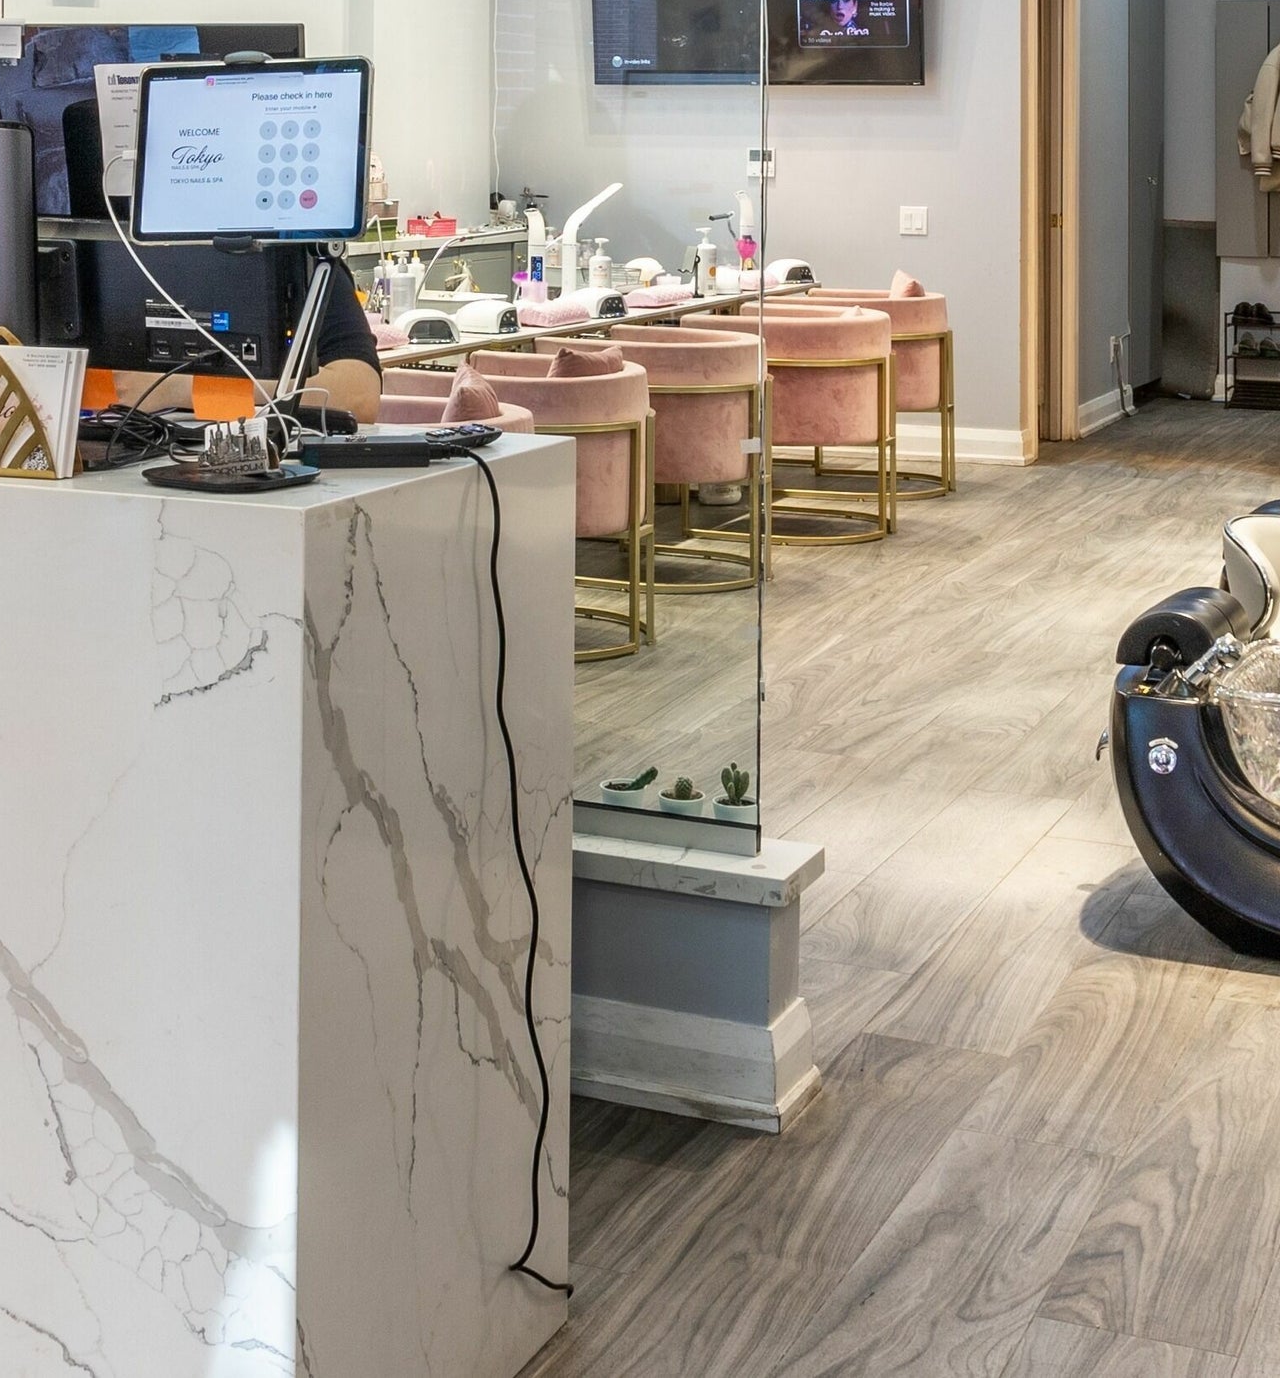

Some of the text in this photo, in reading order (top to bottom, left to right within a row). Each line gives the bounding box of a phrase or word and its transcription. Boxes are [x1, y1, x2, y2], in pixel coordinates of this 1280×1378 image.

[116, 75, 140, 85] TORONT
[251, 91, 333, 101] Please check in here
[178, 127, 221, 137] WELCOME
[171, 144, 225, 171] Tokyo
